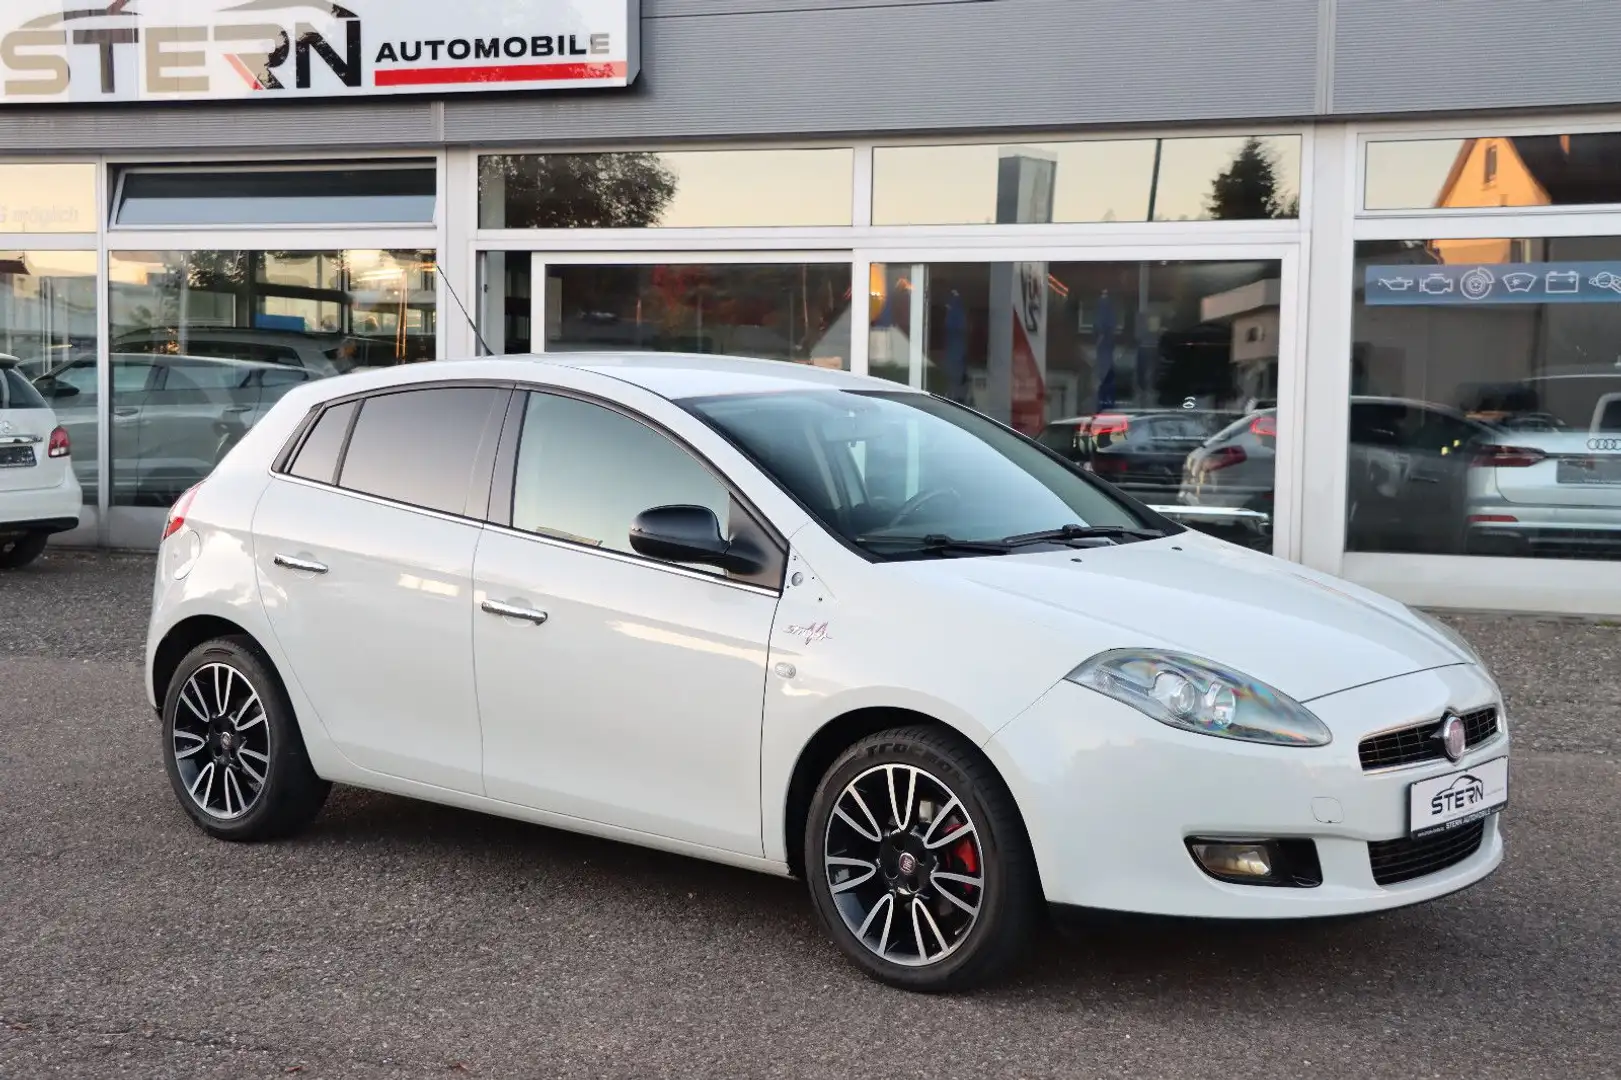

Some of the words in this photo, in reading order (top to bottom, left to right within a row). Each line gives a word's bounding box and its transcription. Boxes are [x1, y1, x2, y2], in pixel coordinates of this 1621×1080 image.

[0, 20, 362, 97] STERN
[375, 33, 610, 63] AUTOMOBILE
[1431, 785, 1484, 815] STERN
